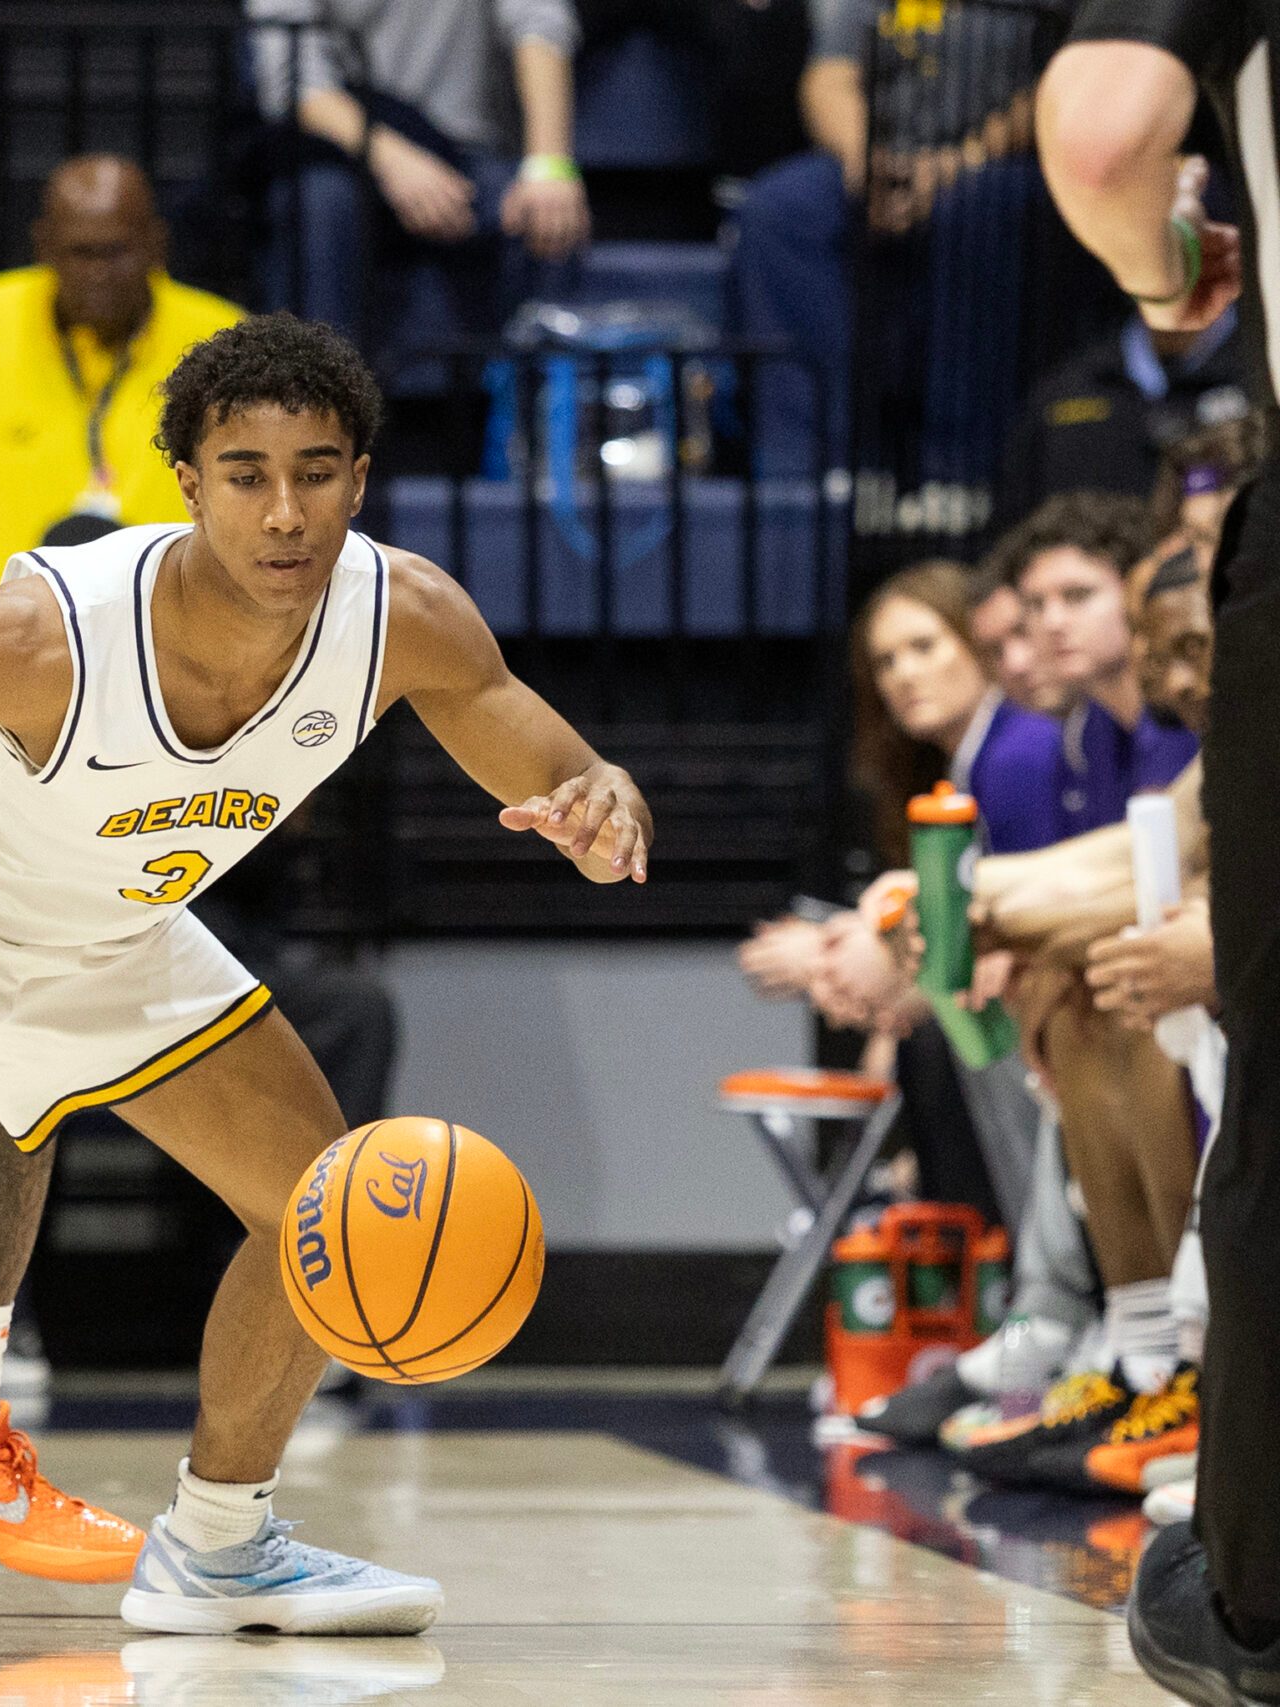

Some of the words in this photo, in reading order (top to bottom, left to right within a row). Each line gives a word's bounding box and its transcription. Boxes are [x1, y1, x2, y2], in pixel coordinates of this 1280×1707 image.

[296, 720, 336, 735] ACC
[96, 788, 280, 838] BEARS
[118, 850, 213, 905] 3
[365, 1151, 428, 1221] Cal
